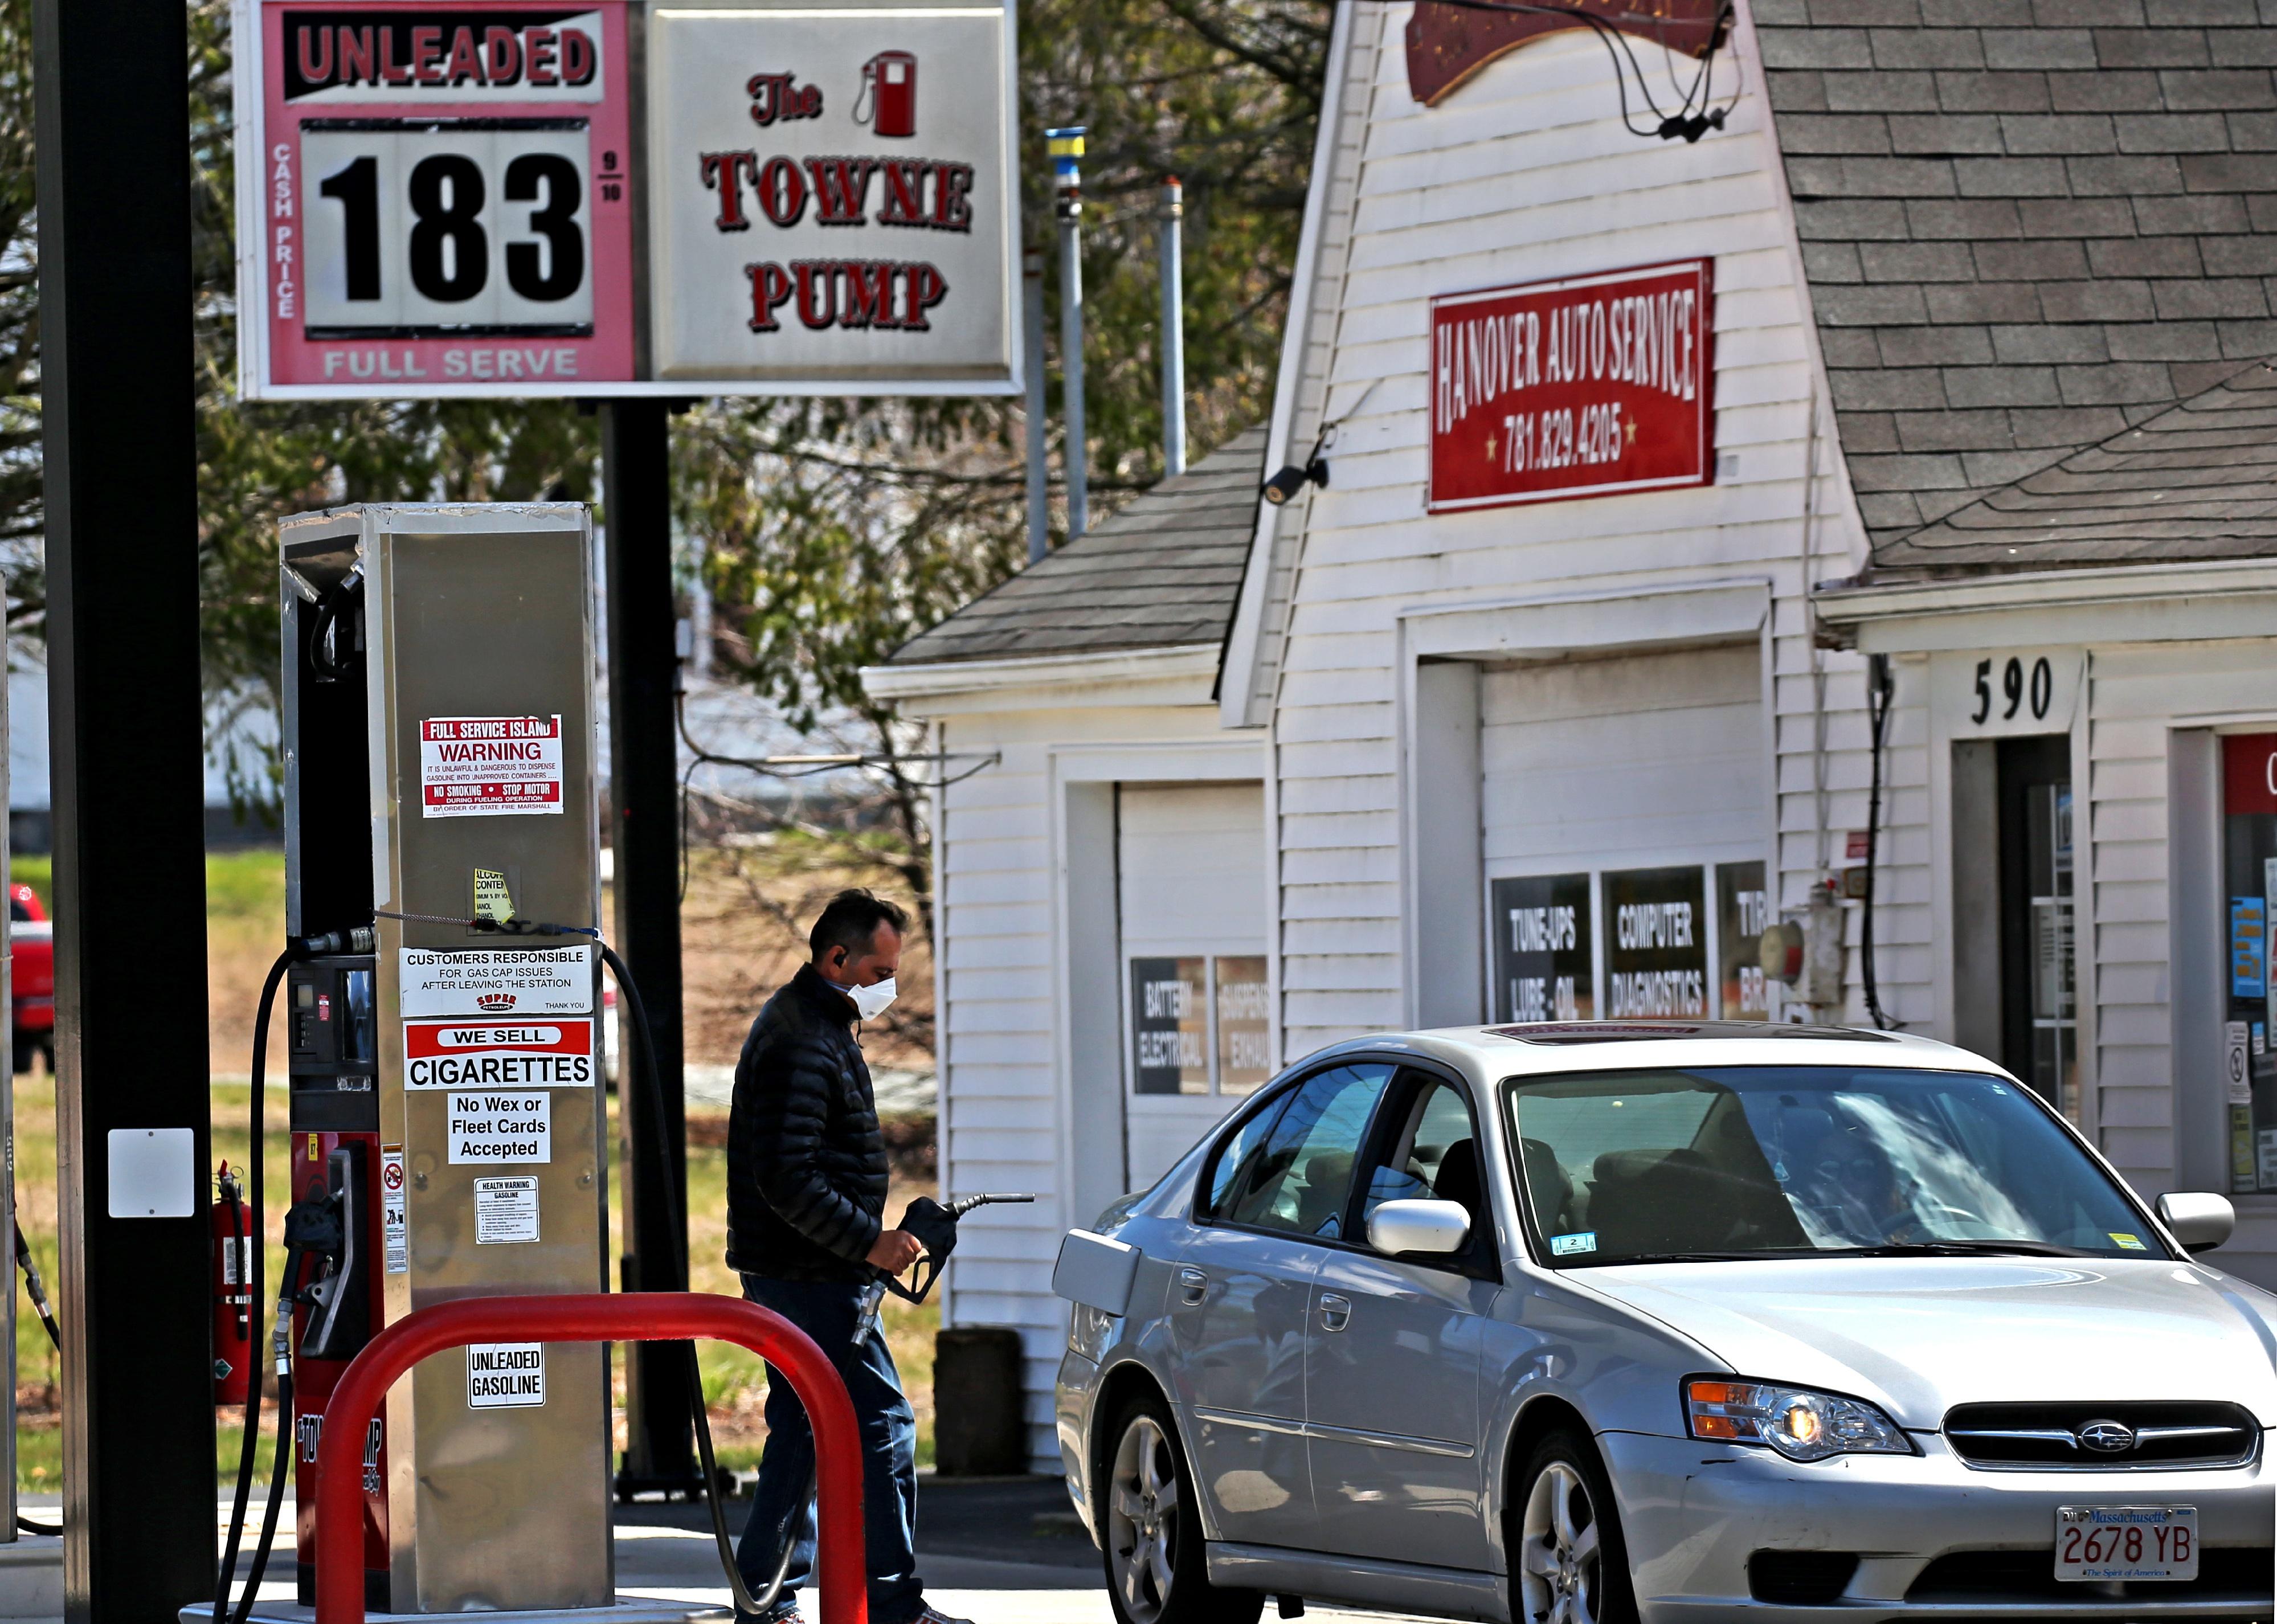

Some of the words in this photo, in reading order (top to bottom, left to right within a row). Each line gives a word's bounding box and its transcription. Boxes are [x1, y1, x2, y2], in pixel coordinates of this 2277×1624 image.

[297, 26, 595, 86] UNLEADED
[747, 69, 823, 126] The
[603, 150, 617, 170] 9
[273, 144, 292, 217] CASH
[602, 183, 621, 202] 10
[700, 149, 974, 234] TOWNE
[321, 153, 584, 303] 183
[275, 227, 294, 319] PRICE
[745, 259, 949, 333] PUMP
[325, 350, 426, 378] FULL
[444, 349, 578, 378] SERVE
[1437, 311, 1540, 435] HANOVER
[1546, 300, 1606, 383] AUTO
[1609, 288, 1695, 401] SERVICE
[1504, 402, 1622, 473] 781.829.4205
[1971, 656, 2051, 725] 590
[430, 723, 456, 739] FULL
[460, 722, 506, 738] SERVICE
[510, 721, 550, 737] ISLAND
[438, 742, 541, 762] WARNING
[434, 786, 443, 797] NO
[447, 785, 481, 797] SMOKING
[502, 784, 522, 796] STOP
[524, 783, 550, 795] MOTOR
[1510, 905, 1576, 952] TUNE-UPS
[1617, 902, 1694, 950] COMPUTER
[407, 954, 489, 965] CUSTOMERS
[493, 952, 583, 964] RESPONSIBLE
[440, 969, 461, 977] FOR
[467, 968, 489, 977] GAS
[492, 968, 512, 977] CAP
[516, 967, 552, 976] ISSUES
[422, 980, 455, 990] AFTER
[459, 980, 503, 989] LEAVING
[506, 980, 525, 988] THE
[529, 979, 571, 988] STATION
[1612, 970, 1703, 1017] DIAGNOSTICS
[476, 993, 517, 1006] SUPER
[453, 1030, 487, 1044] WE
[493, 1029, 545, 1042] SELL
[410, 1057, 589, 1086] CIGARETTES
[457, 1097, 479, 1112] No
[485, 1097, 519, 1111] Wex
[524, 1099, 541, 1111] or
[452, 1119, 492, 1134] Fleet
[497, 1119, 546, 1133] Cards
[460, 1140, 537, 1159] Accepted
[472, 1351, 539, 1371] UNLEADED
[472, 1375, 540, 1396] GASOLINE
[2089, 1510, 2166, 1523] Massachusetts
[2064, 1526, 2143, 1563] 2678
[2154, 1526, 2190, 1562] YB
[2103, 1569, 2122, 1578] Spirit
[2124, 1569, 2132, 1577] of
